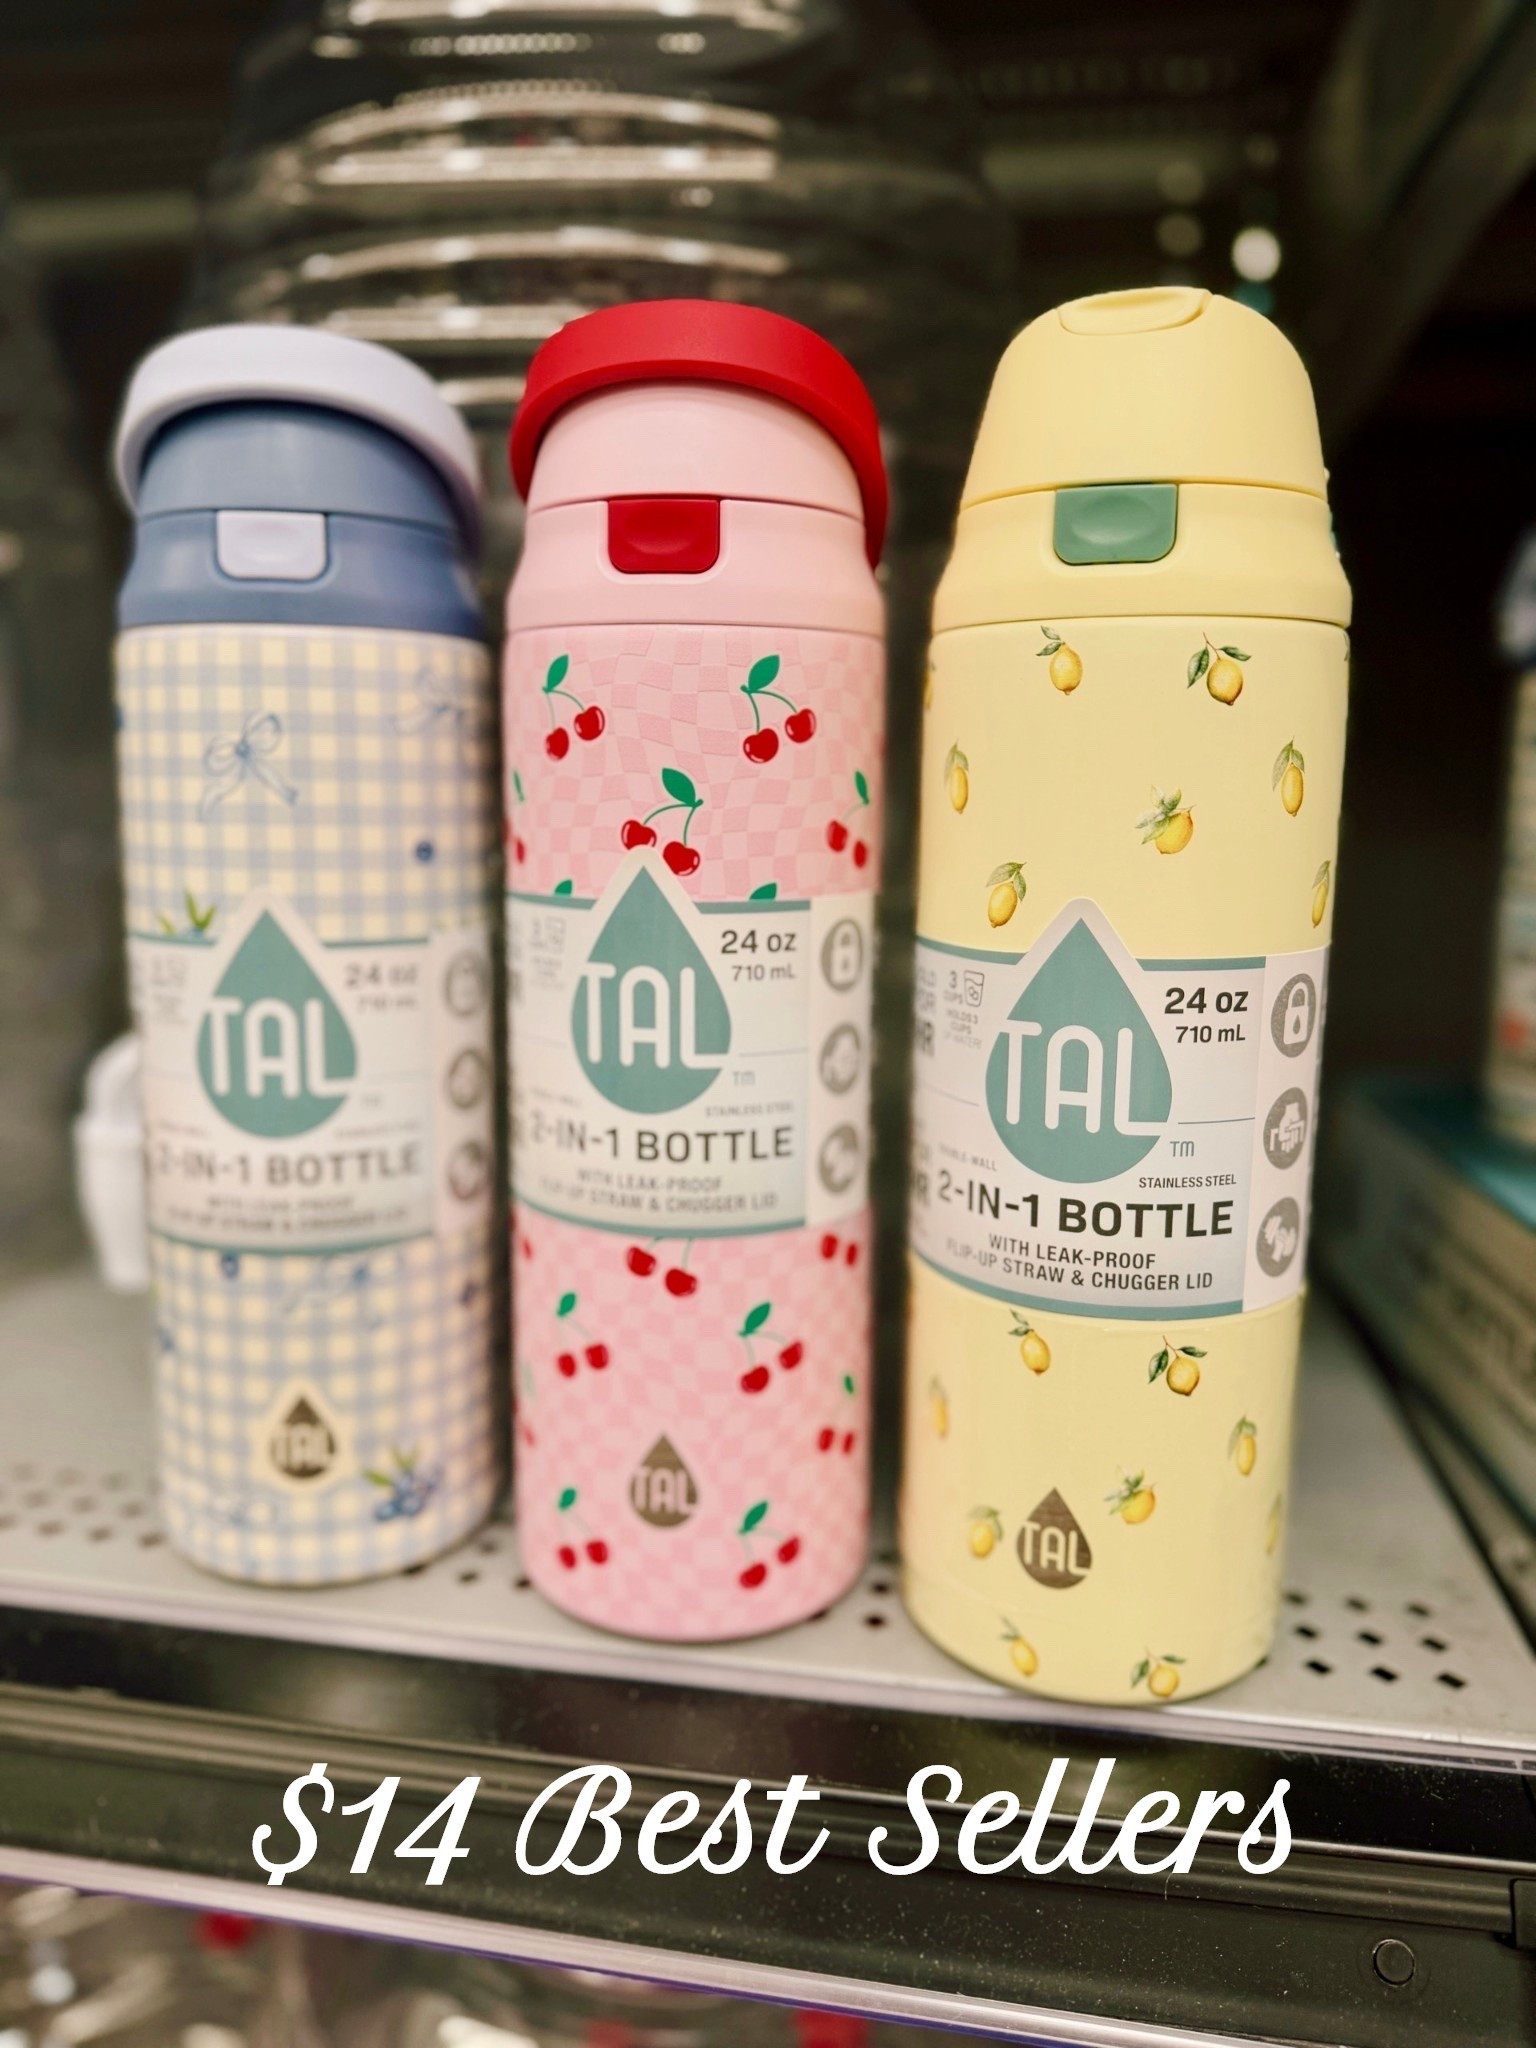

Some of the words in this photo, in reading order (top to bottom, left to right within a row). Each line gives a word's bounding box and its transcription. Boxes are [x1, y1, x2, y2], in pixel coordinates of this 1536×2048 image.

[720, 930, 758, 954] 24
[767, 932, 797, 953] oz
[732, 965, 764, 981] 710
[770, 964, 797, 980] mL
[579, 962, 729, 1069] TAL
[1164, 987, 1206, 1014] 24
[1215, 990, 1248, 1012] oz
[201, 996, 355, 1098] TAL
[1175, 1025, 1212, 1043] 710
[1217, 1024, 1246, 1041] mL
[1000, 1019, 1168, 1136] TAL
[705, 1103, 763, 1119] STAINLESS
[530, 1109, 618, 1158] 2-IN-1
[636, 1126, 793, 1163] BOTTLE
[1169, 1141, 1195, 1157] TM
[266, 1142, 420, 1187] BOTTLE
[617, 1173, 723, 1192] LEAK-PROOF
[1138, 1175, 1203, 1189] STAINLESS
[1204, 1174, 1237, 1187] STEEL
[938, 1168, 1039, 1228] 2-IN-1
[1058, 1196, 1234, 1239] BOTTLE
[946, 1236, 998, 1268] FLIP-UP
[1002, 1258, 1065, 1284] STRAW
[1071, 1269, 1085, 1287] &
[1091, 1271, 1180, 1291] CHUGGER
[1186, 1271, 1213, 1289] LID
[989, 1232, 1030, 1257] WITH
[1036, 1243, 1156, 1270] LEAK-PROOF
[272, 1420, 338, 1470] TAL
[633, 1464, 697, 1515] TAL
[1020, 1520, 1091, 1576] TAL
